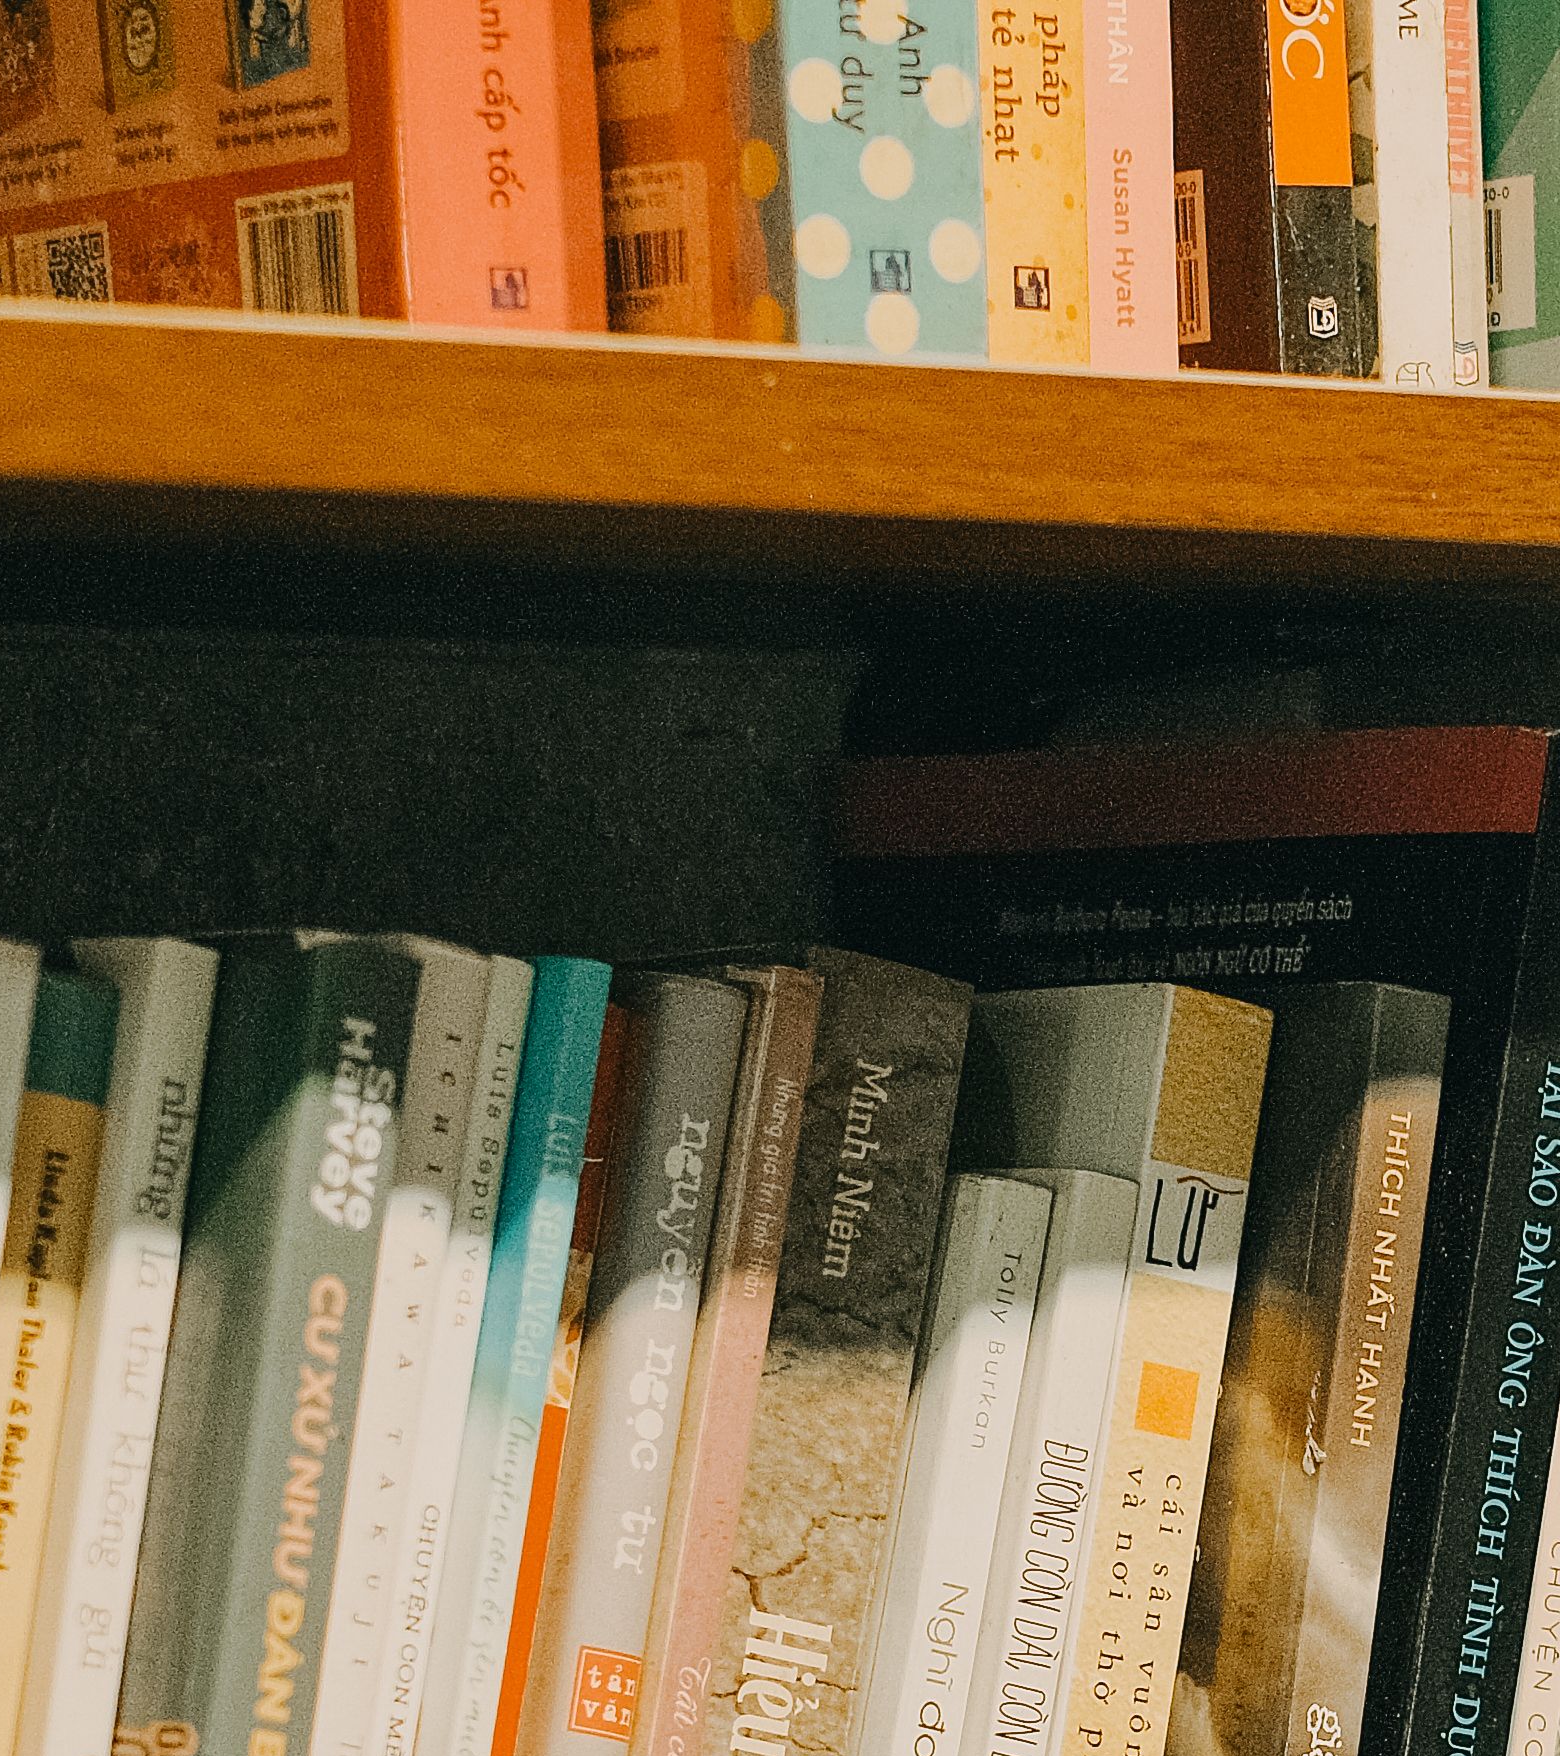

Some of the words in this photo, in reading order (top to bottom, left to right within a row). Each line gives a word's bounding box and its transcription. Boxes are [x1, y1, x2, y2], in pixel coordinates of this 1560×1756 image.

[898, 16, 932, 98] Anh
[991, 9, 1025, 47] tẻ
[1033, 12, 1068, 118] pháp
[475, 68, 521, 132] cấp
[832, 57, 874, 134] duy
[986, 65, 1022, 163] nhạt
[488, 148, 526, 209] tốc
[1112, 148, 1133, 235] Susan
[1112, 247, 1136, 328] Hyatt
[313, 1016, 376, 1222] Harvey
[486, 1042, 516, 1119] Luis
[841, 1059, 892, 1160] Minh
[134, 1078, 198, 1225] những
[338, 1067, 397, 1236] Steve
[1379, 1113, 1411, 1217] THÍCH
[457, 1133, 502, 1326] Sepúlveda
[647, 1114, 709, 1309] nguyễn
[822, 1173, 874, 1278] Niệm
[136, 1245, 181, 1289] lá
[990, 1252, 1023, 1323] Tolly
[1366, 1230, 1397, 1329] NHẤT
[1513, 1221, 1556, 1306] ĐÀN
[121, 1323, 161, 1398] thư
[972, 1340, 1006, 1449] Burkan
[1351, 1342, 1383, 1447] HẠNH
[1497, 1321, 1545, 1408] ÔNG
[627, 1340, 675, 1471] ngọc
[86, 1432, 148, 1573] không
[1029, 1440, 1089, 1543] ĐƯỜNG
[1117, 1463, 1153, 1514] và
[1152, 1471, 1195, 1539] cái
[1475, 1428, 1522, 1558] THÍCH
[404, 1504, 440, 1634] CHUYỆN
[613, 1505, 656, 1575] tư
[1018, 1549, 1071, 1613] CÒN
[1101, 1529, 1146, 1603] nơi
[66, 1603, 120, 1673] gửi
[926, 1582, 969, 1689] Nghĩ
[1136, 1561, 1179, 1637] sân
[1457, 1577, 1504, 1678] TÌNH
[393, 1643, 416, 1706] CON
[586, 1660, 641, 1697] tản
[1005, 1617, 1060, 1670] DÀI,
[1093, 1631, 1125, 1705] thờ
[579, 1694, 634, 1728] văn
[673, 1657, 712, 1725] Tất
[995, 1682, 1048, 1746] CÒN
